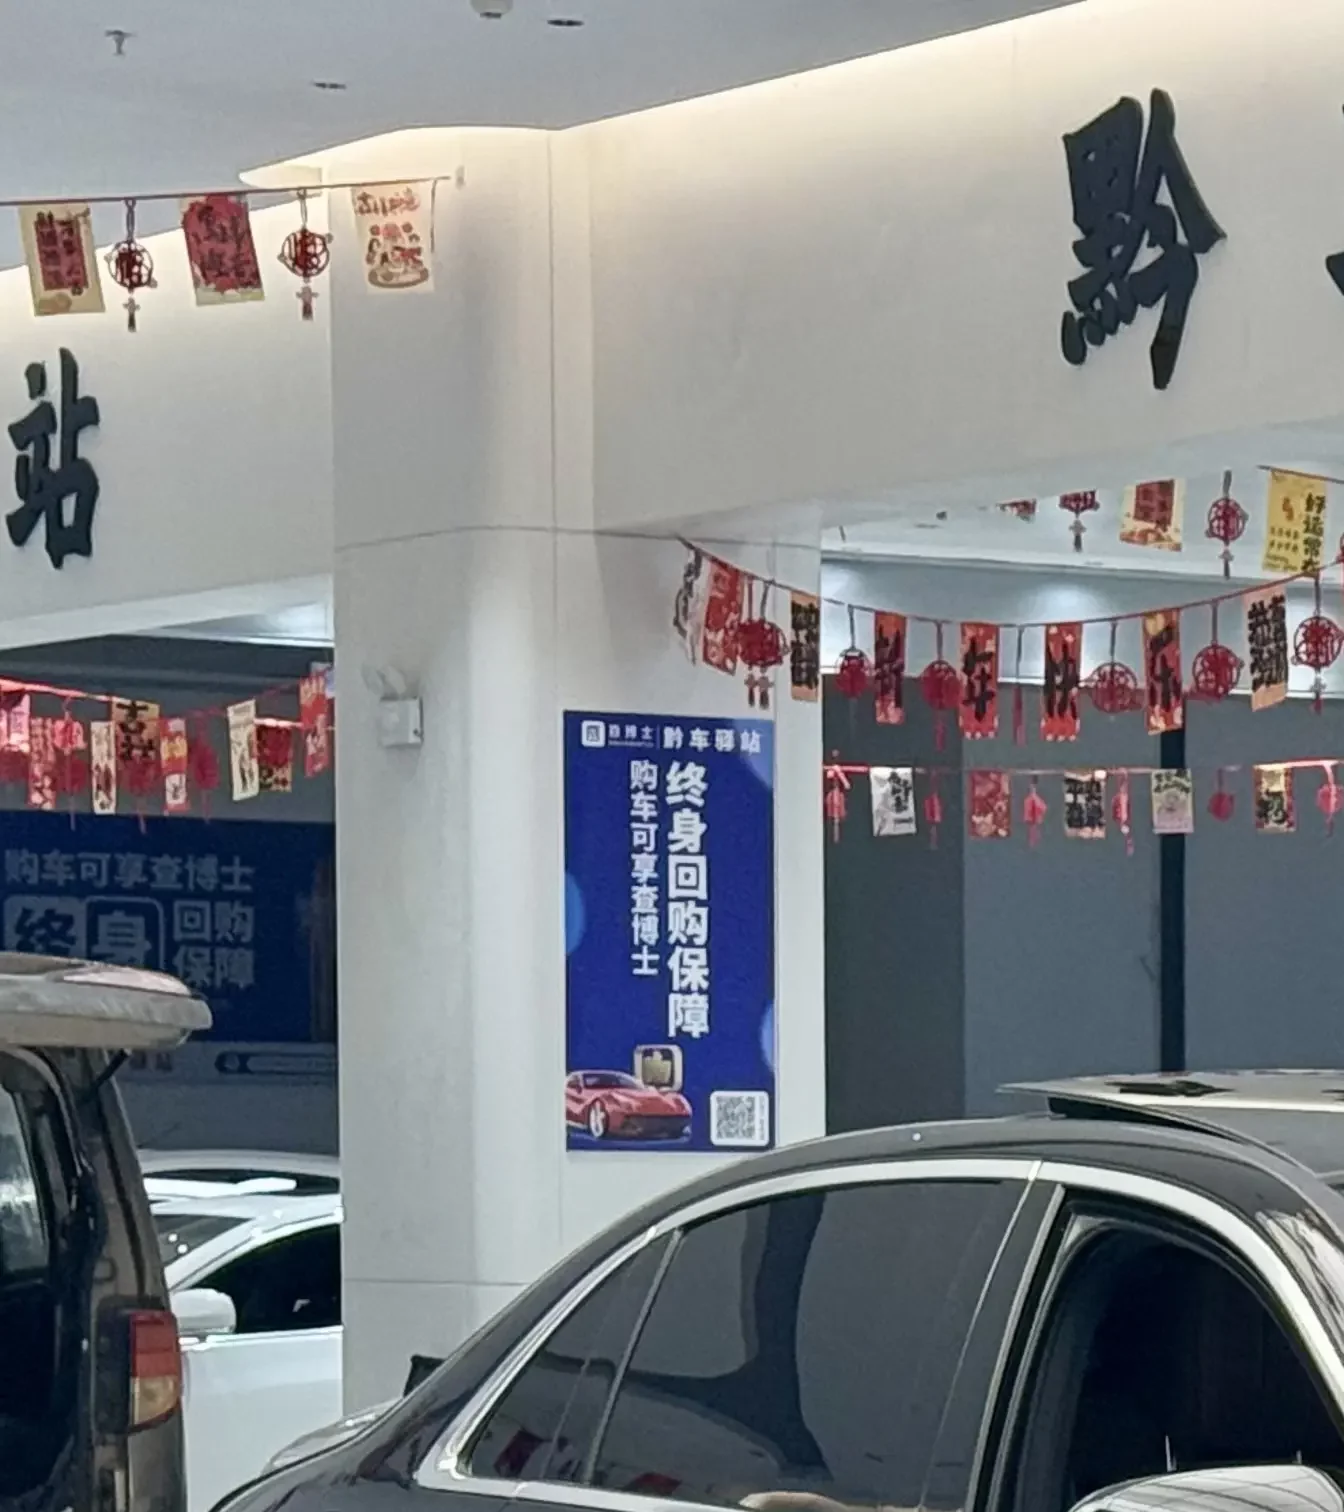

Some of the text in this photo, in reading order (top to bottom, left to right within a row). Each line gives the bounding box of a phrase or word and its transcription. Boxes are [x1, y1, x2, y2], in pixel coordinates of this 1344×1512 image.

[6, 348, 99, 570] 站
[4, 848, 255, 893] 购车可享查博士
[172, 900, 255, 945] 回购
[629, 759, 659, 976] 购车可享查博士
[665, 760, 710, 1039] 终身回购保障
[172, 945, 255, 989] 保障
